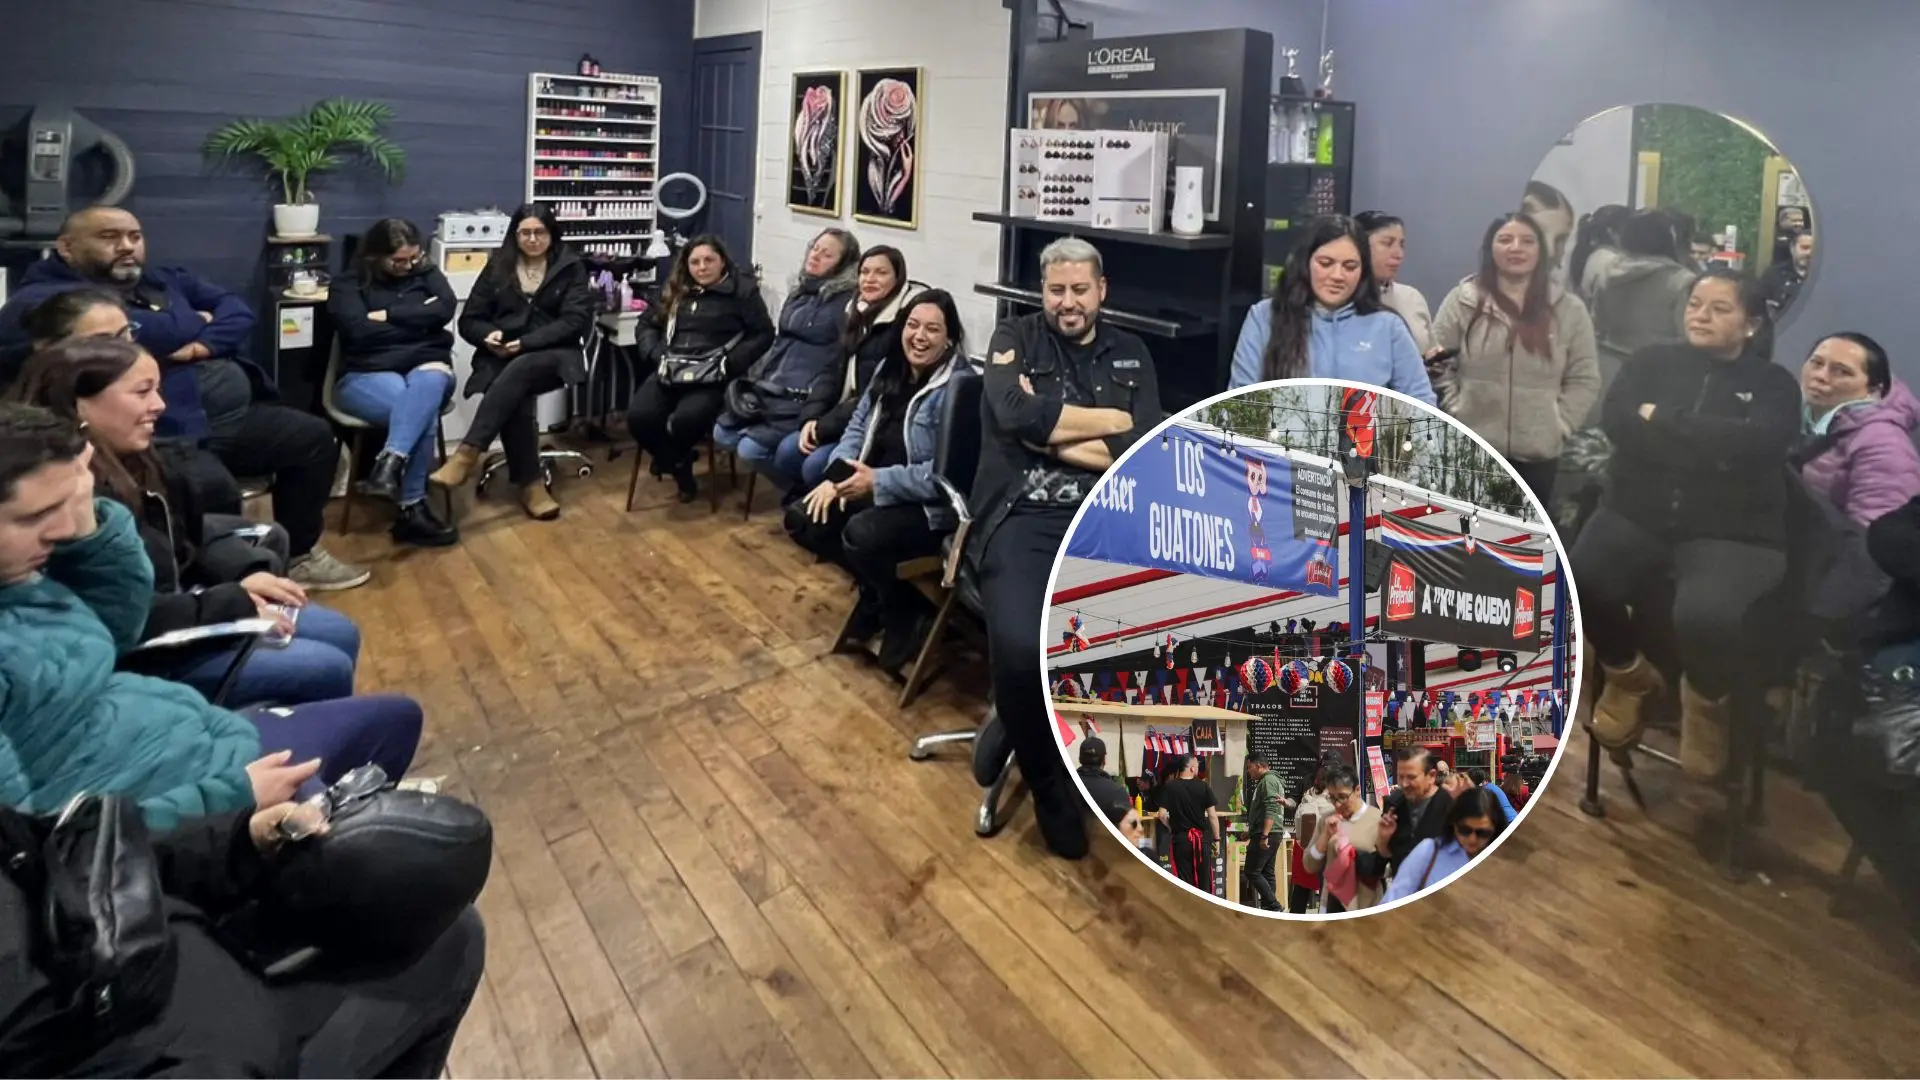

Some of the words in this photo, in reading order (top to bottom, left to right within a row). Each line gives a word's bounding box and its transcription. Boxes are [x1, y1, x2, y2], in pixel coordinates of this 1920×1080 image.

[1175, 436, 1206, 498] LOS
[1297, 467, 1333, 488] ADVERTENCIA
[1300, 487, 1316, 498] consumo
[1322, 491, 1334, 502] alcohol
[1300, 499, 1316, 509] menores
[1150, 502, 1235, 572] GUATONES
[1394, 573, 1401, 588] La
[1390, 585, 1414, 608] Preferida
[1422, 584, 1432, 615] A
[1456, 590, 1473, 622] ME
[1474, 594, 1511, 627] QUEDO
[1196, 726, 1212, 740] CAJA
